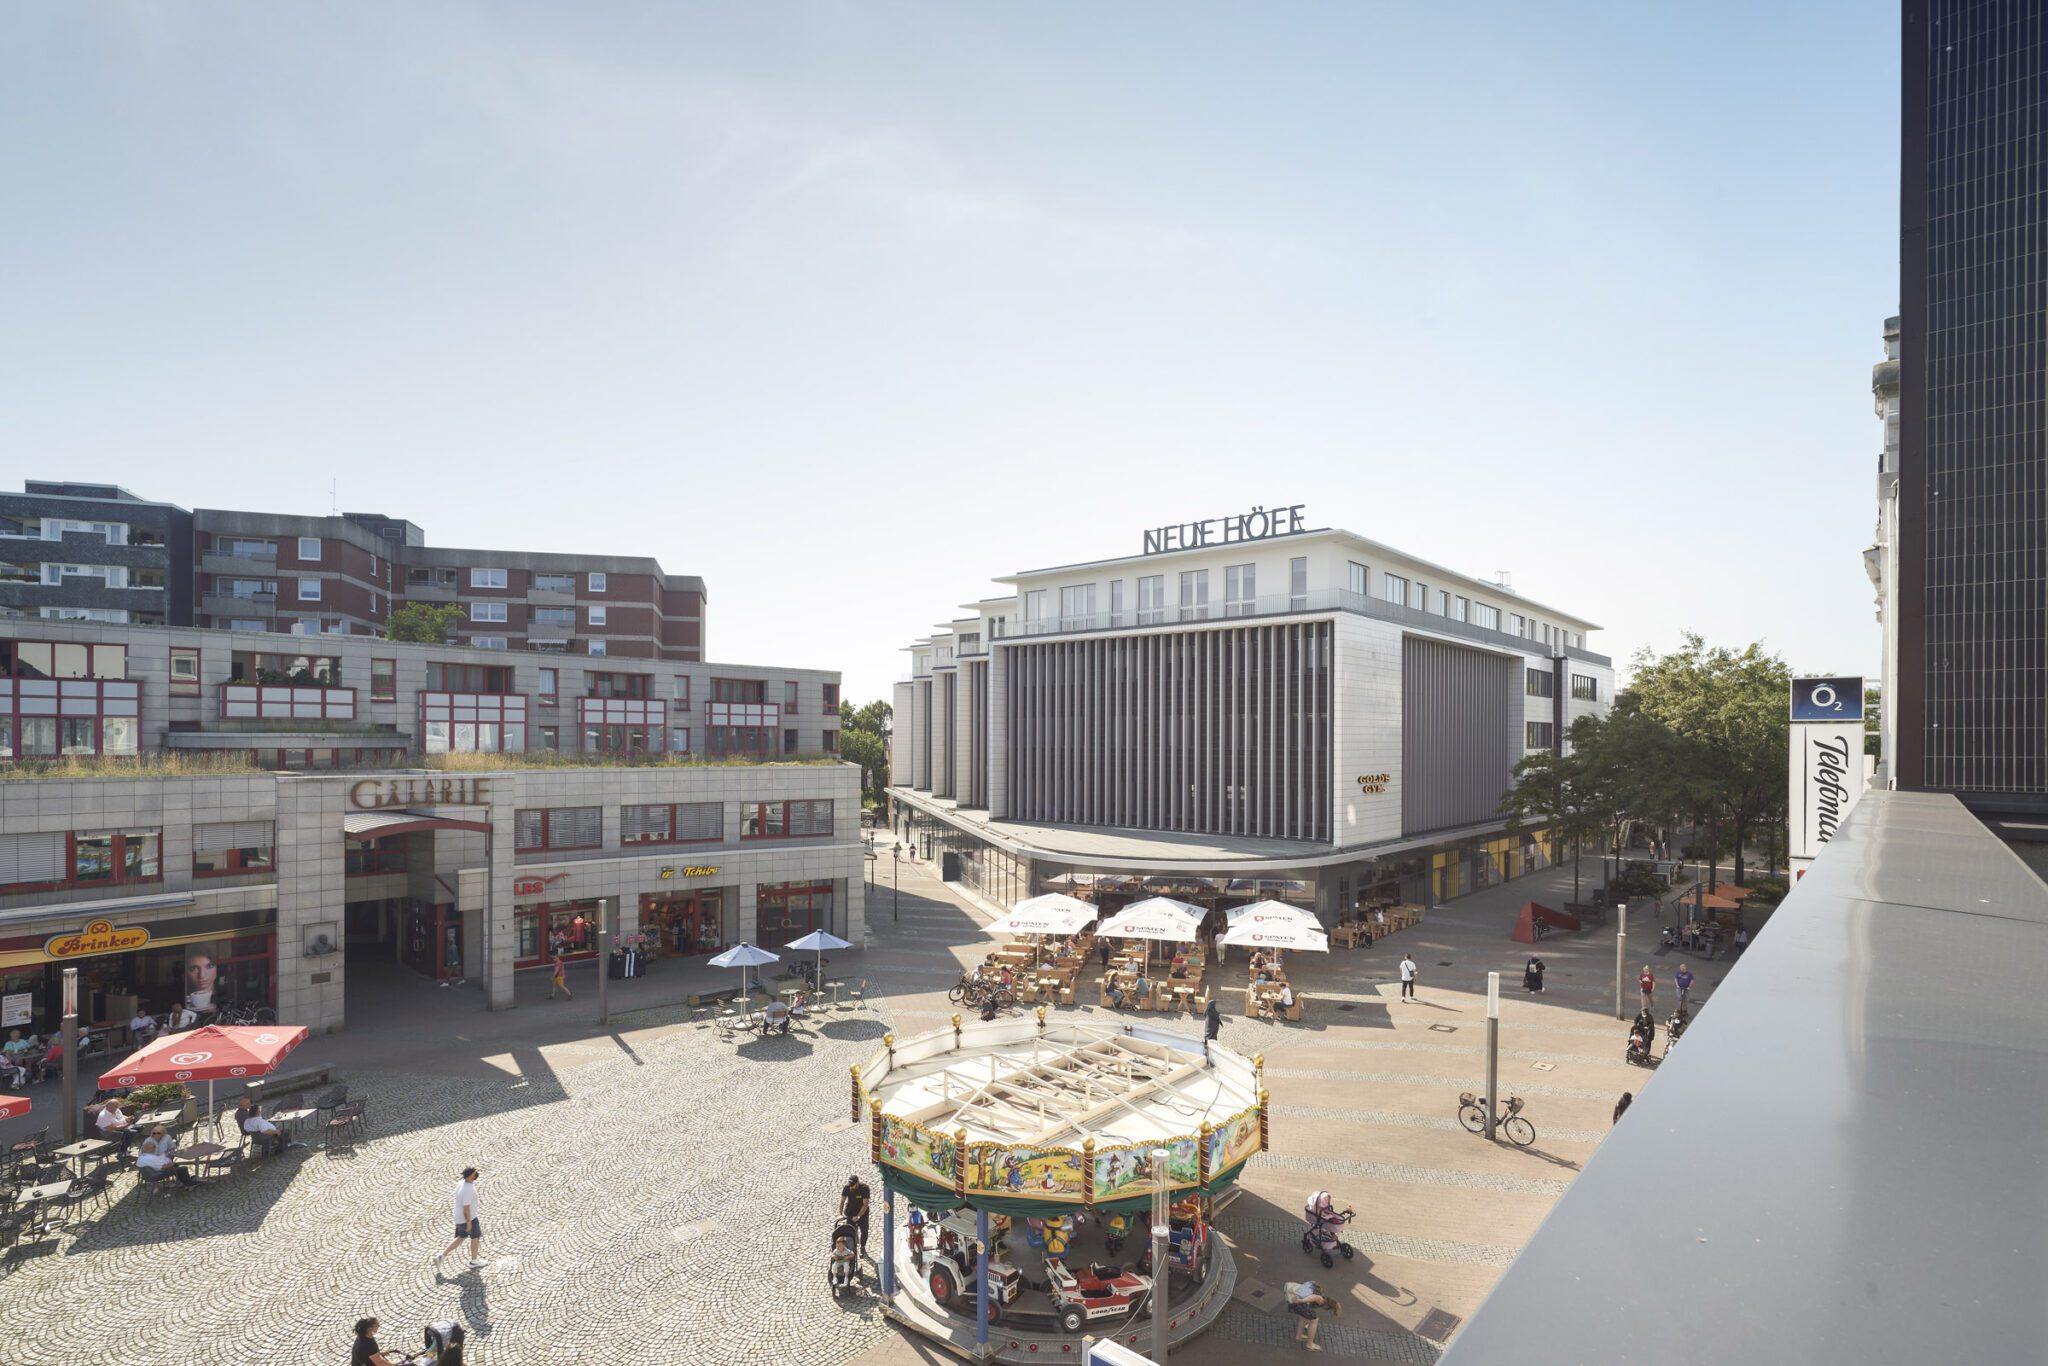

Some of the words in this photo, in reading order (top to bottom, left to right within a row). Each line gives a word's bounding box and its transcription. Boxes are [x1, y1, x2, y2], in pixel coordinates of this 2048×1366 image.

[1144, 518, 1215, 555] NEUE
[1224, 504, 1306, 544] HÖFE
[390, 778, 465, 791] STADT
[350, 778, 490, 809] GALERIE
[683, 866, 721, 877] Tchibo
[514, 882, 544, 896] LBS
[57, 936, 140, 955] Brinker
